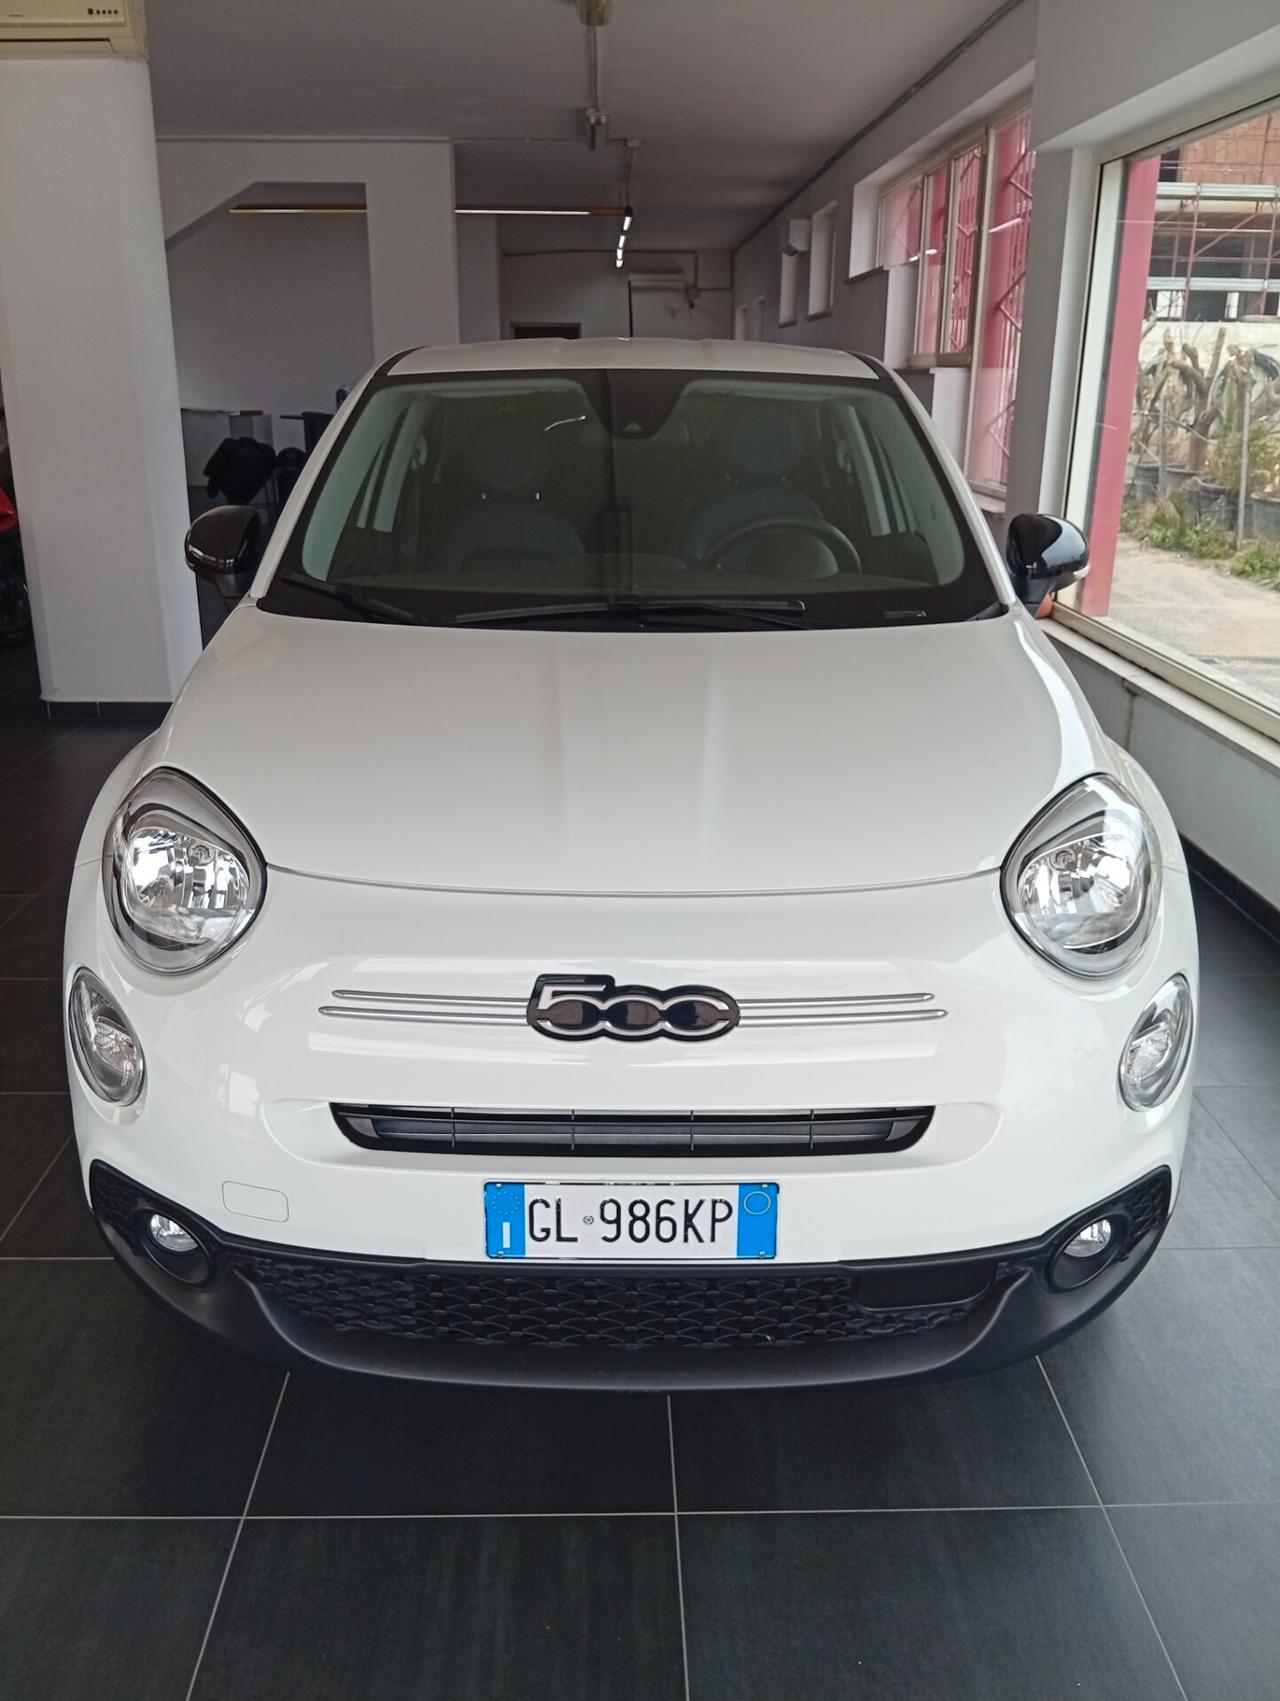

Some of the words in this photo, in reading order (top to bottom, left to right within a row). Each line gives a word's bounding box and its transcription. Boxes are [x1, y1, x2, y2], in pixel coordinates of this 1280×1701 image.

[527, 974, 740, 1042] 500
[528, 1198, 578, 1243] GL
[599, 1198, 734, 1244] 986KP
